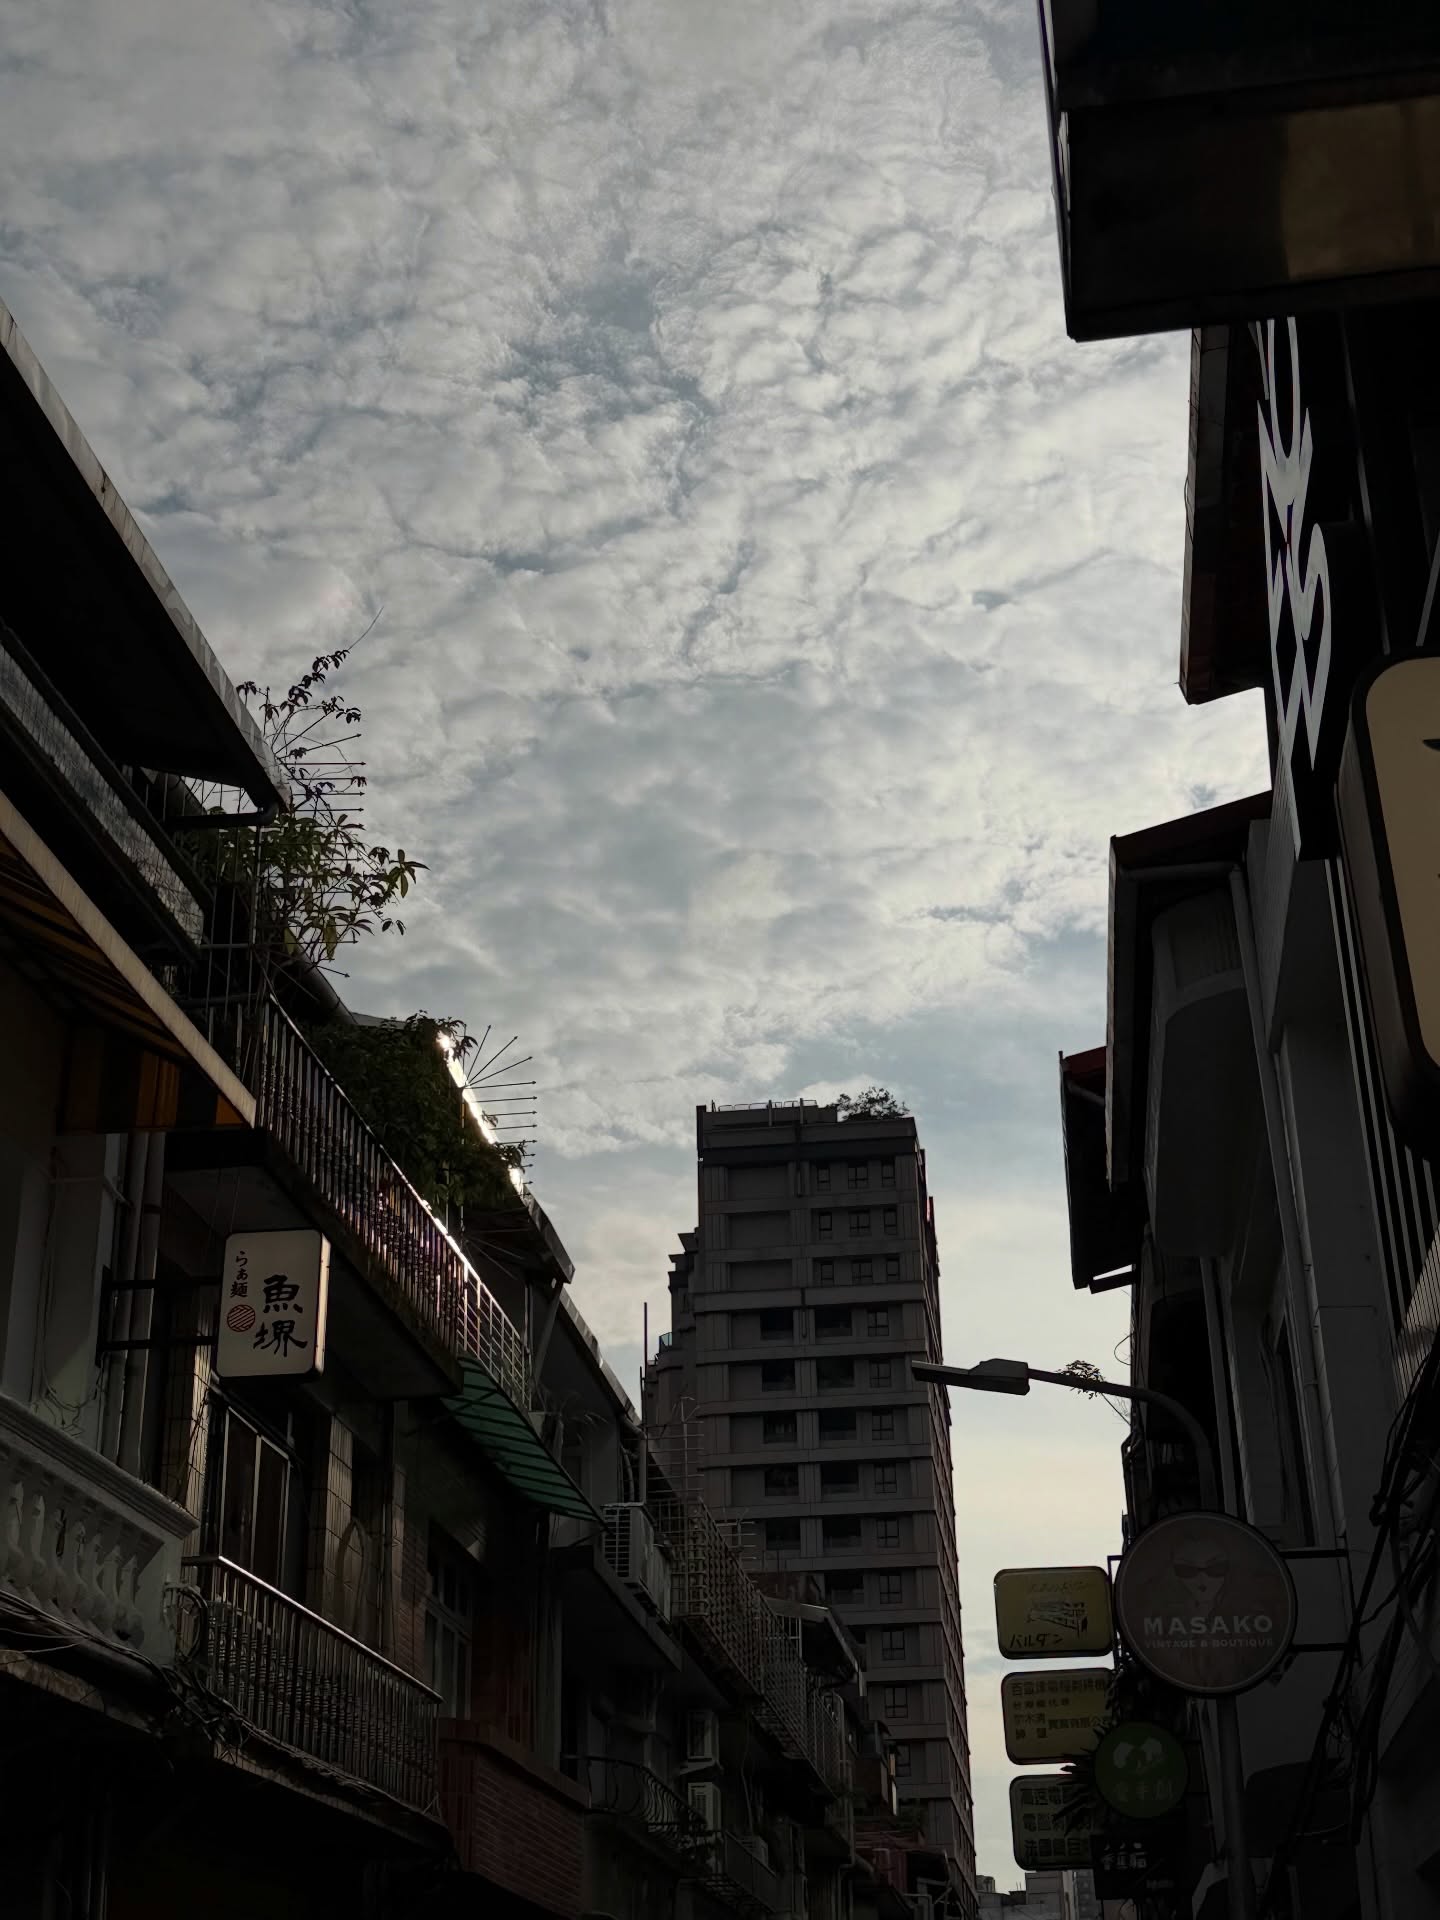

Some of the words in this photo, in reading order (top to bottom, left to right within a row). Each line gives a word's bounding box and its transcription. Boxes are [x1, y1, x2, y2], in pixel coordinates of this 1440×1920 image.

[253, 1274, 308, 1357] 魚堺
[1142, 1615, 1273, 1635] MASAKO
[1144, 1639, 1195, 1649] VINTAGE
[1211, 1637, 1273, 1648] BOUTIQUE
